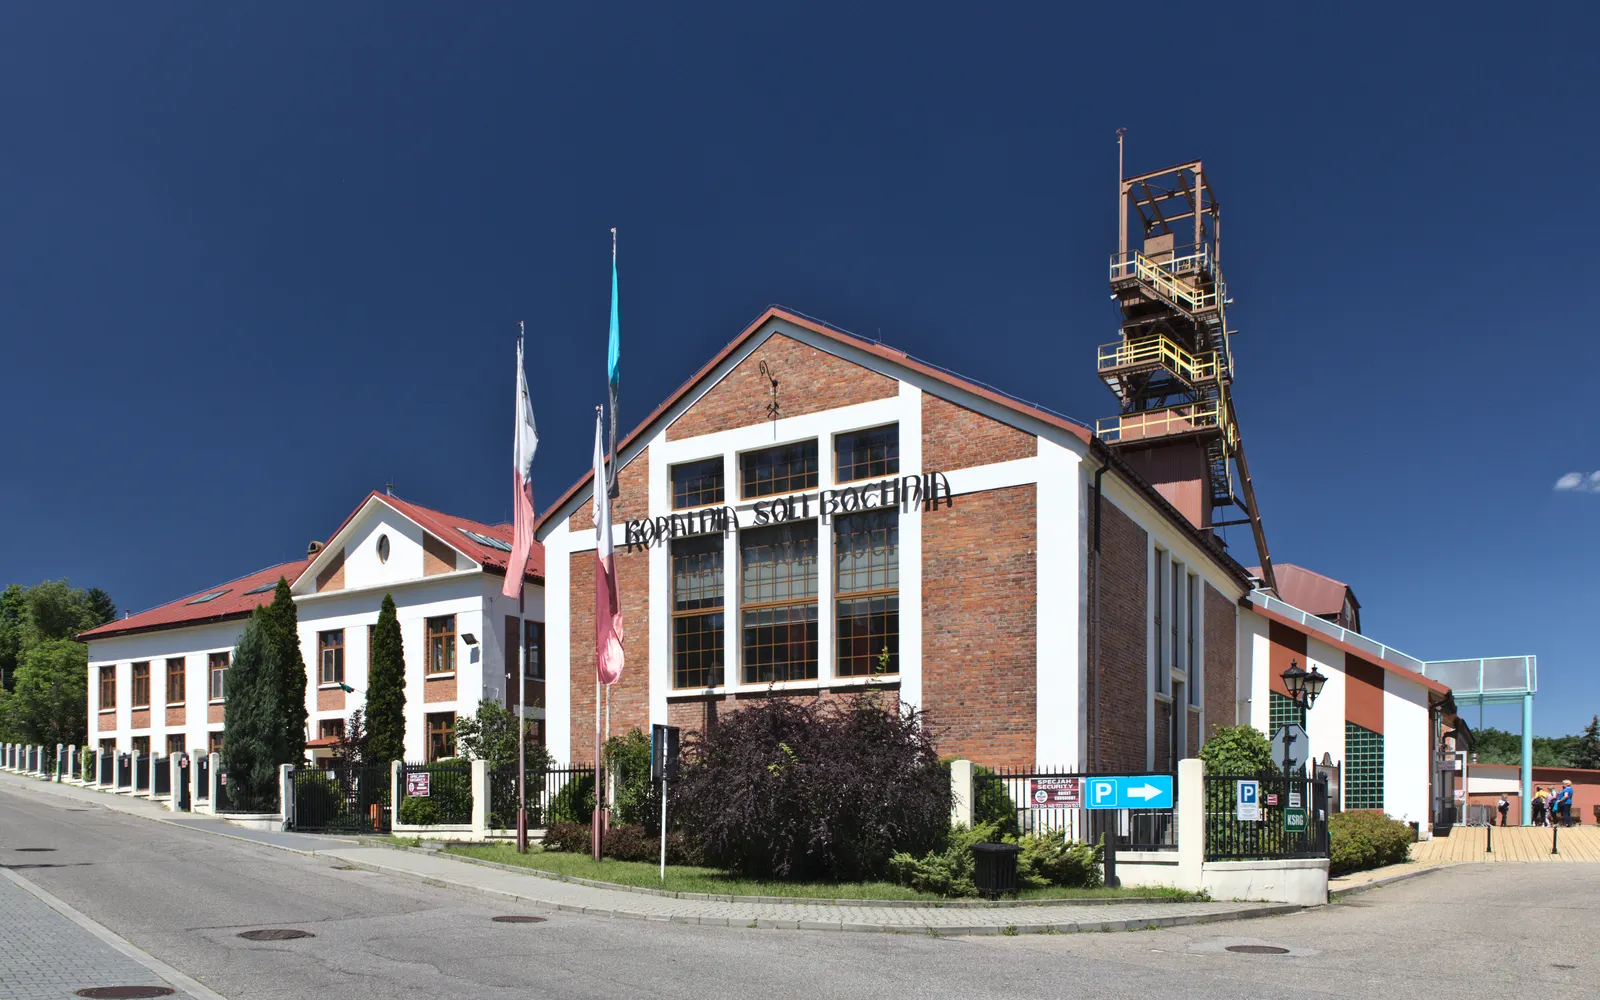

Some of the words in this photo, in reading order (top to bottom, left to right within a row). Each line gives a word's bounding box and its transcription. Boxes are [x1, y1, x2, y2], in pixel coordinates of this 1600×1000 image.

[625, 506, 739, 544] KOPALNIA
[753, 493, 808, 525] SOLI
[820, 471, 951, 515] BOCHNIA
[1096, 783, 1112, 803] P
[1244, 786, 1254, 801] P
[1287, 814, 1304, 826] KSRG
